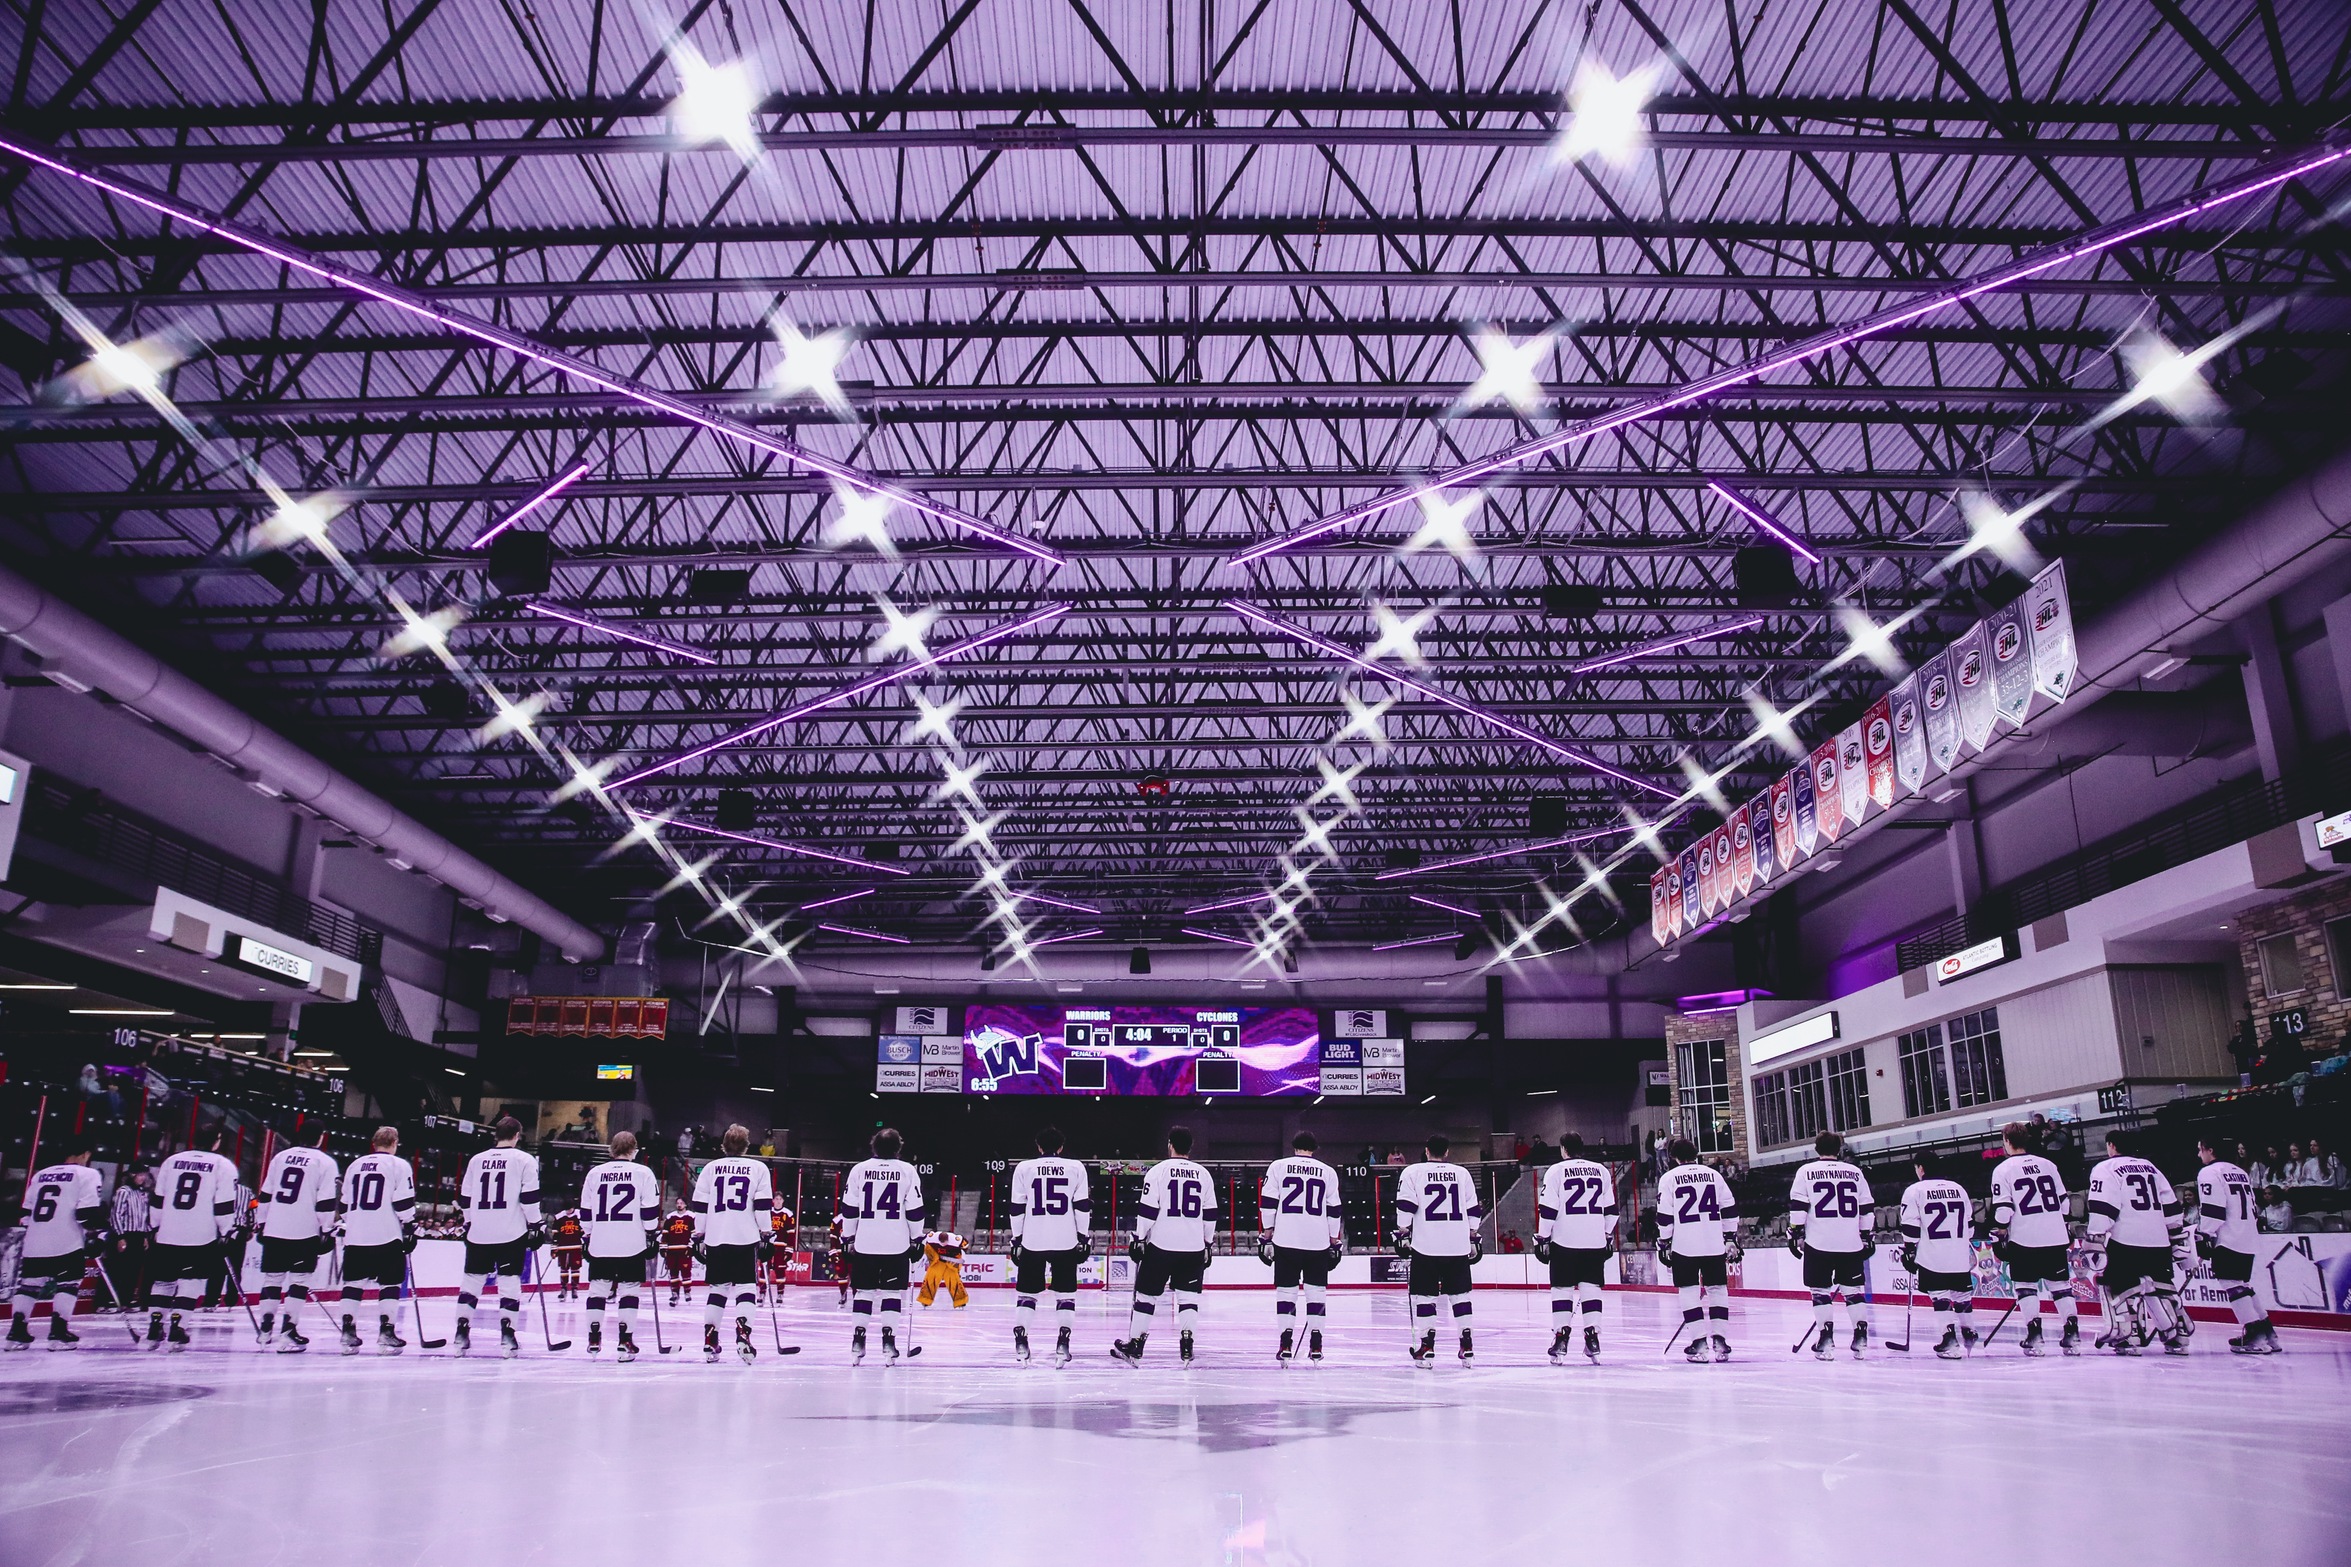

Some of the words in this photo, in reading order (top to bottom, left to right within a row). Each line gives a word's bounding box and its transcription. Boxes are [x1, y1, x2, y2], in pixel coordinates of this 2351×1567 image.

[258, 949, 299, 975] CURRIES
[1066, 1010, 1110, 1020] WARRIORS
[1196, 1012, 1238, 1022] CYCLONES
[2274, 1013, 2304, 1034] 13
[114, 1027, 137, 1047] 106
[1077, 1029, 1084, 1040] 0
[1125, 1028, 1152, 1041] 4:04
[1223, 1030, 1230, 1041] 0
[887, 1046, 912, 1054] BUSCH
[925, 1067, 959, 1078] MIDWEST
[1366, 1070, 1401, 1080] MIDWEST
[328, 1077, 344, 1093] 106
[971, 1077, 998, 1091] 6:55
[424, 1115, 437, 1129] 107
[173, 1160, 214, 1173] KOIVUNEN
[285, 1155, 310, 1167] CAPLE
[360, 1162, 378, 1172] DICK
[481, 1159, 508, 1170] CLARK
[984, 1160, 1006, 1172] 109
[714, 1165, 751, 1175] WALLACE
[864, 1170, 901, 1181] MOLSTAD
[1037, 1166, 1064, 1176] TOEWS
[1170, 1167, 1200, 1179] CARNEY
[1287, 1164, 1323, 1177] DERMOTT
[1346, 1166, 1367, 1177] 110
[1565, 1168, 1601, 1178] ANDERSON
[2022, 1164, 2041, 1176] INKS
[600, 1172, 632, 1182] INGRAM
[1428, 1172, 1456, 1182] PILEGGI
[1675, 1173, 1715, 1185] VIGNAROLI
[172, 1172, 202, 1210] 8
[275, 1166, 305, 1205] 9
[350, 1173, 386, 1211] 10
[478, 1171, 507, 1210] 11
[2091, 1180, 2103, 1193] 31
[714, 1175, 751, 1213] 13
[1031, 1178, 1069, 1216] 15
[1167, 1179, 1202, 1219] 16
[1281, 1176, 1326, 1217] 20
[1564, 1177, 1603, 1215] 22
[1926, 1189, 1961, 1200] AGUILERA
[2013, 1175, 2061, 1216] 28
[2126, 1174, 2162, 1211] 31
[33, 1184, 61, 1223] 6
[595, 1183, 636, 1222] 12
[860, 1181, 900, 1220] 14
[1424, 1183, 1463, 1221] 21
[1674, 1184, 1721, 1224] 24
[1813, 1181, 1858, 1218] 26
[1924, 1201, 1965, 1239] 27
[560, 1224, 579, 1232] STATE
[670, 1223, 689, 1231] STATE
[962, 1263, 994, 1272] TRIC
[1892, 1278, 1908, 1290] ASSA
